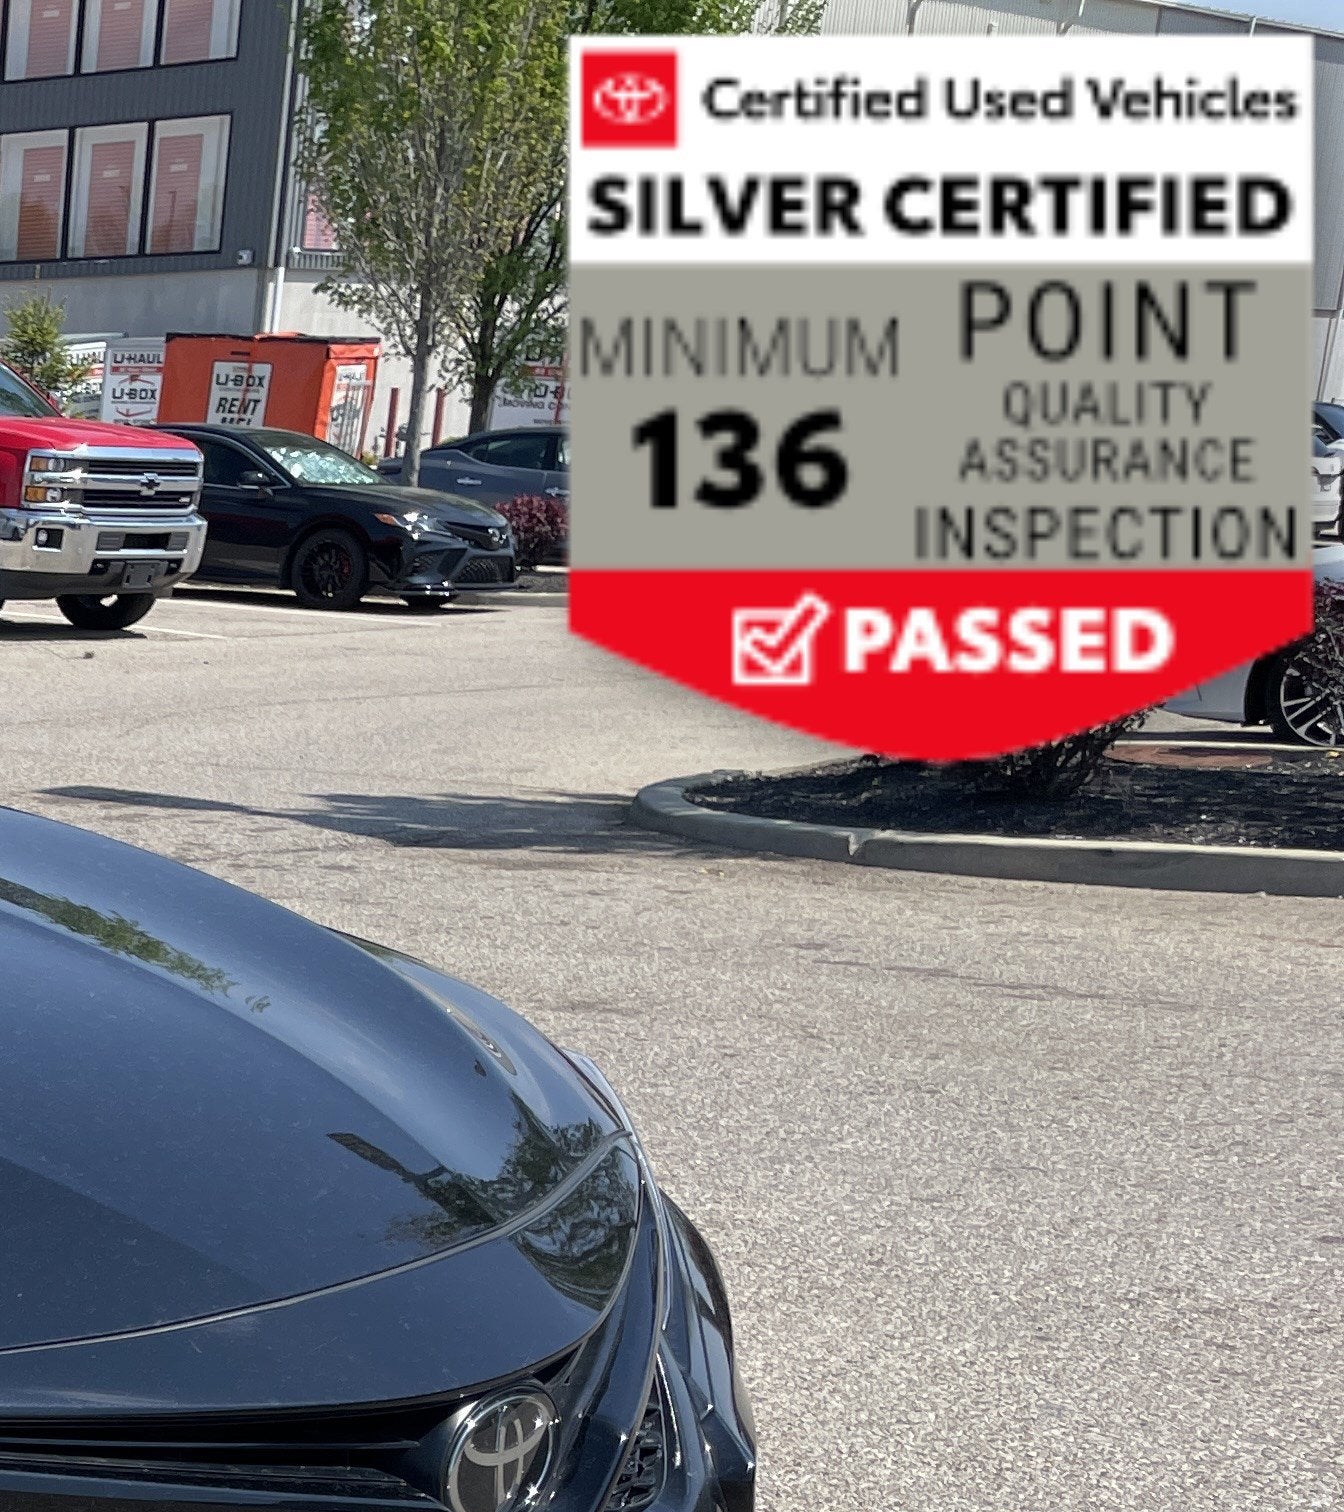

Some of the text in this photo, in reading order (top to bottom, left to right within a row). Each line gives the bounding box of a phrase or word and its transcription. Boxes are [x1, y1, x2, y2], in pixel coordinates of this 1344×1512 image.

[113, 353, 162, 364] U-HAUL
[215, 373, 266, 388] U-BOX
[112, 387, 158, 400] U-BOX
[215, 397, 261, 415] RENT
